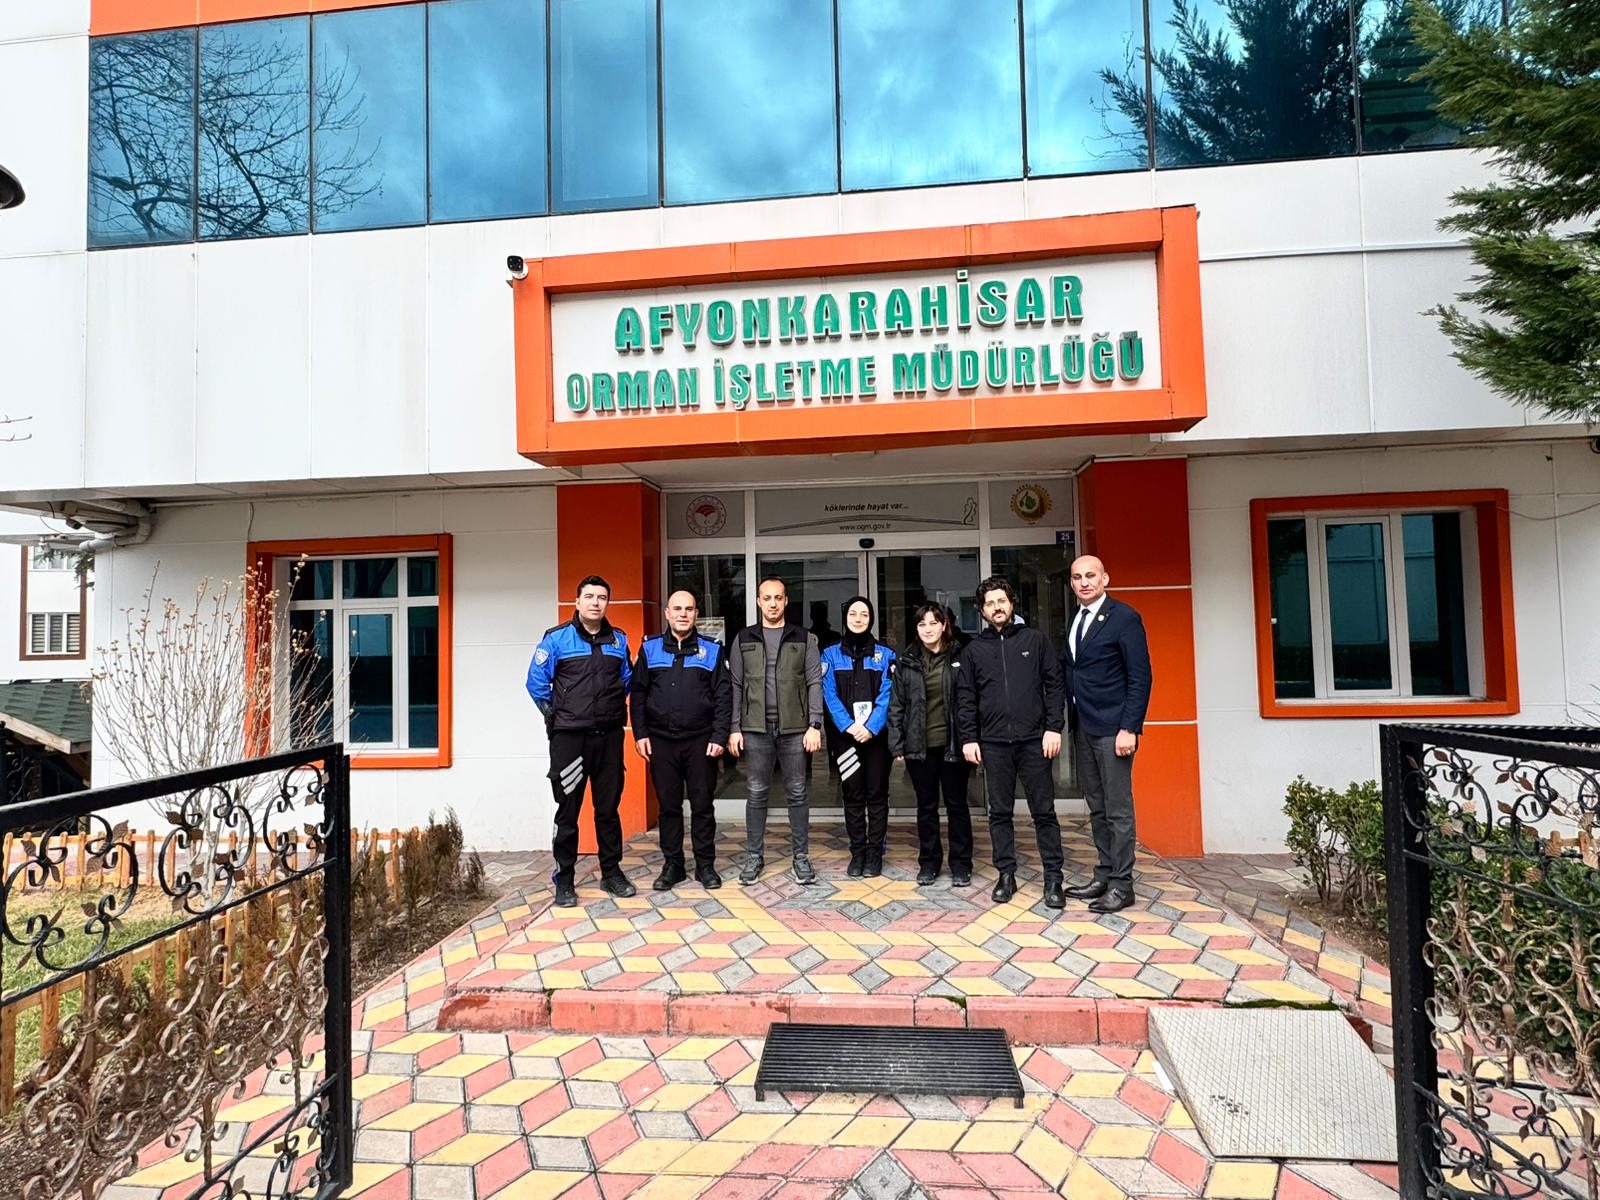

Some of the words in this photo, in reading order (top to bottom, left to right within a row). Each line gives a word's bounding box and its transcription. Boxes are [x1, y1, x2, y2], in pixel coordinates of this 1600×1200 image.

[614, 269, 1084, 353] AFYONKARAHİSAR
[566, 366, 701, 413] ORMAN
[712, 355, 878, 410] İŞLETME
[892, 330, 1145, 395] MÜDÜRLÜĞÜ
[824, 503, 866, 512] köklerinde
[867, 503, 889, 511] hayat
[1060, 533, 1071, 541] 25
